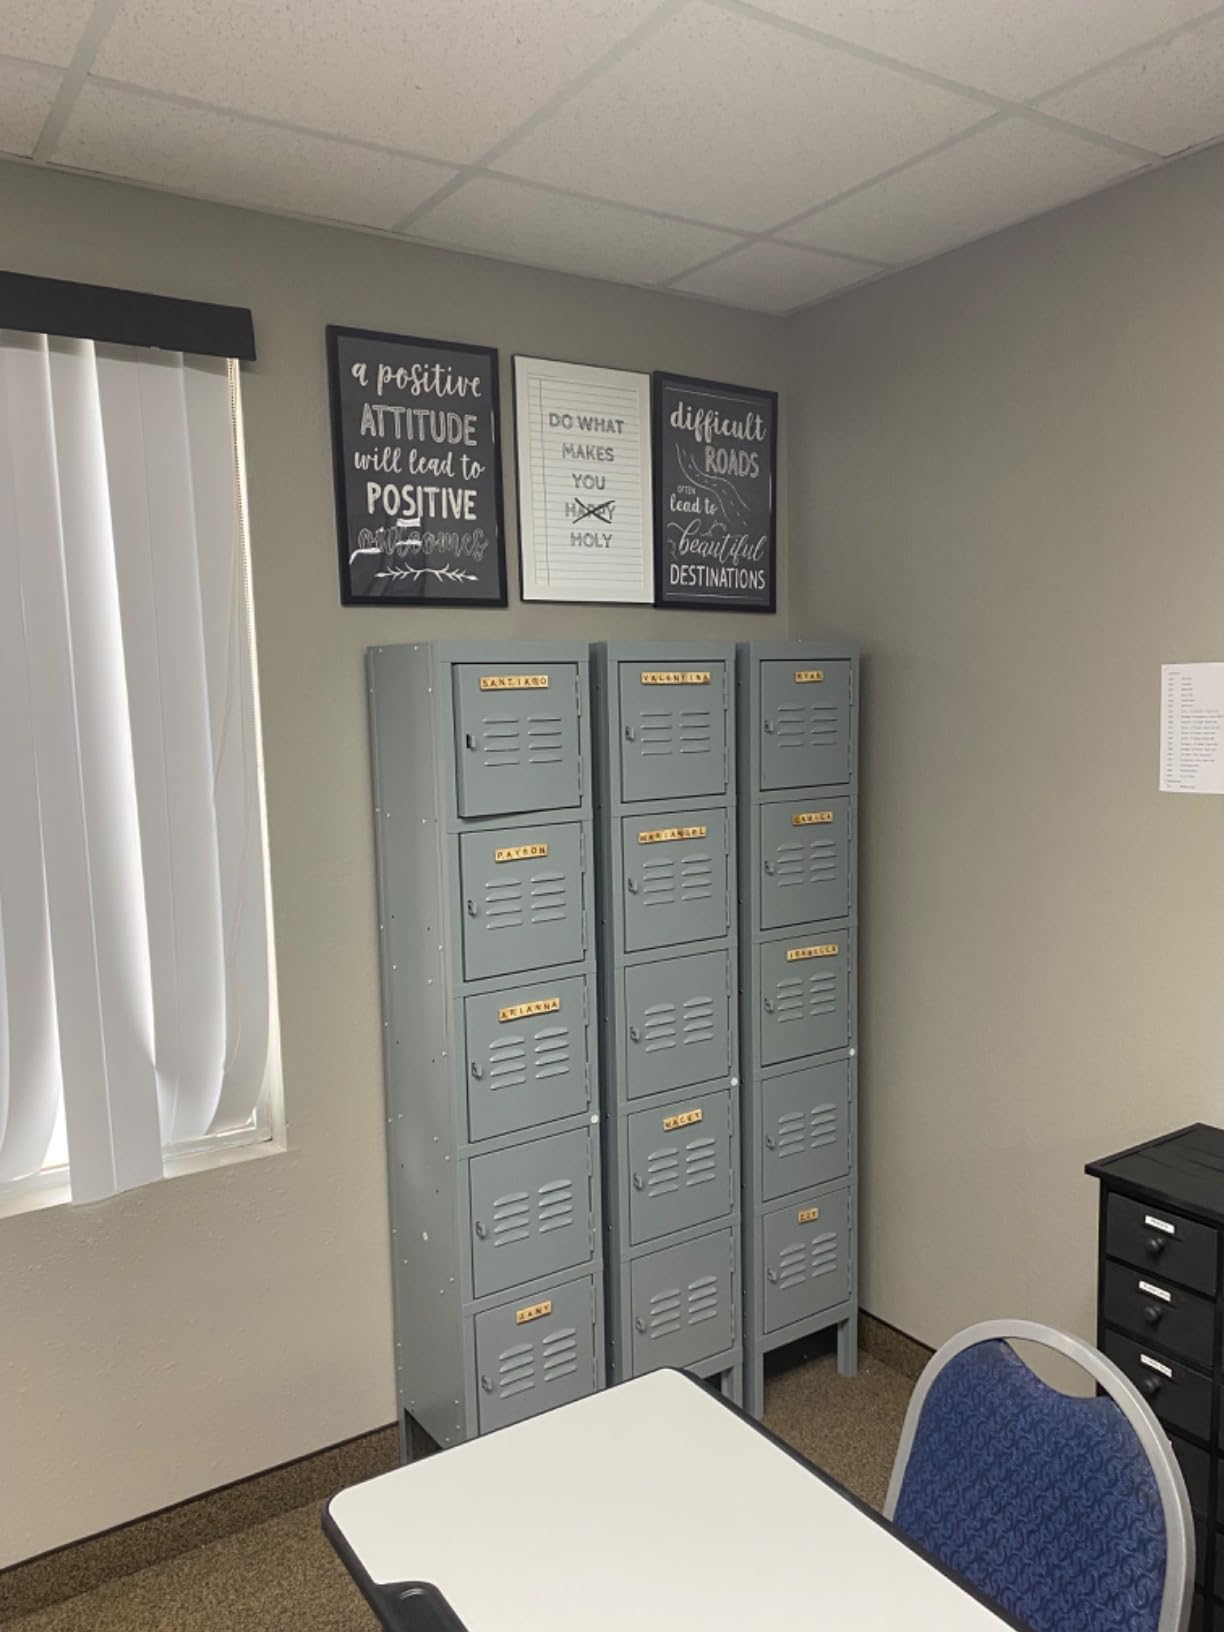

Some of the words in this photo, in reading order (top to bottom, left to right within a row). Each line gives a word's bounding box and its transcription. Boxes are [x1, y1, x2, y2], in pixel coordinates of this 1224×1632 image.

[351, 362, 368, 386] a
[377, 363, 482, 397] positive
[360, 403, 478, 446] ATTITUDE
[549, 412, 573, 429] DO
[577, 415, 625, 434] WHAT
[670, 401, 768, 443] difficult
[354, 447, 403, 473] will
[409, 448, 456, 478] lead
[460, 456, 486, 481] to
[562, 442, 615, 462] MAKES
[705, 445, 760, 479] ROADS
[572, 473, 606, 491] YOU
[677, 485, 697, 496] OFTEN
[367, 481, 477, 520] POSITIVE
[670, 494, 701, 514] lead
[704, 498, 719, 516] to
[570, 532, 613, 549] HOLY
[679, 519, 768, 566] beautiful
[670, 563, 766, 590] DESTINATIONS
[480, 676, 549, 690] SANTIAGO
[500, 1000, 559, 1020] ARIANNA
